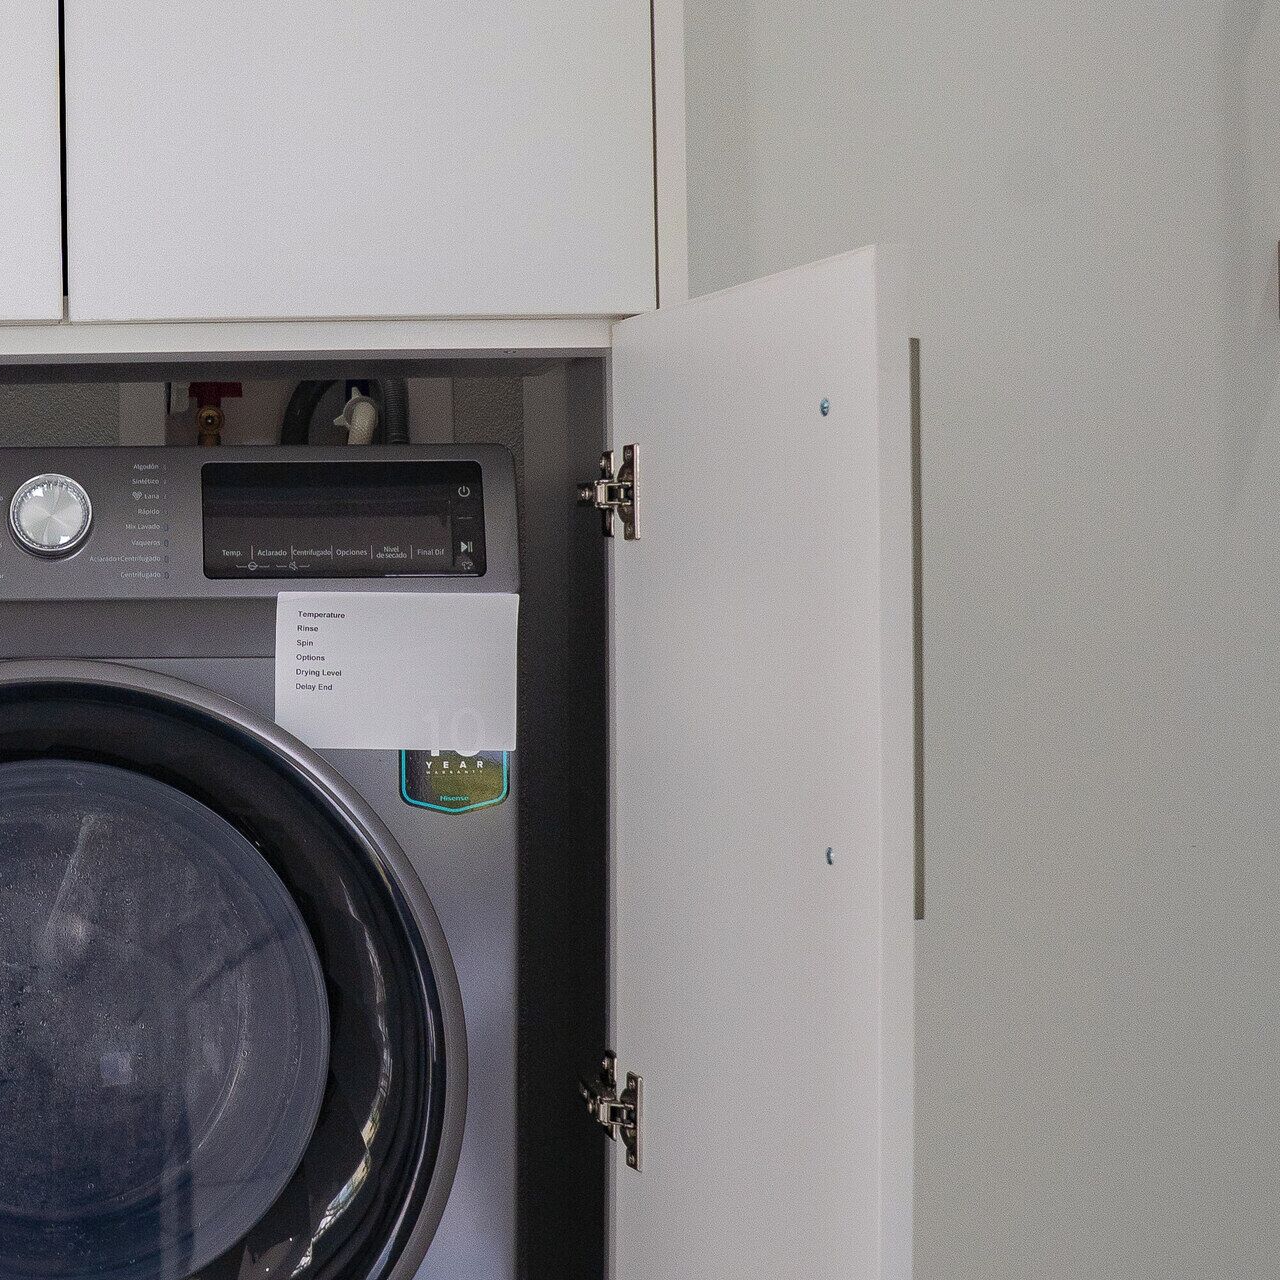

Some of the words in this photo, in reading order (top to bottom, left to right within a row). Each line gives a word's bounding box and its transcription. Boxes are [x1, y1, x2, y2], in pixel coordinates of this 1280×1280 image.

[222, 549, 243, 557] Temp.
[293, 548, 332, 557] Centrifugado
[336, 548, 367, 557] Opciones
[417, 548, 433, 556] Final
[298, 611, 345, 619] Temperature
[296, 654, 325, 662] Options
[296, 669, 320, 677] Drying
[296, 683, 316, 691] Delay
[426, 761, 483, 769] YEAR
